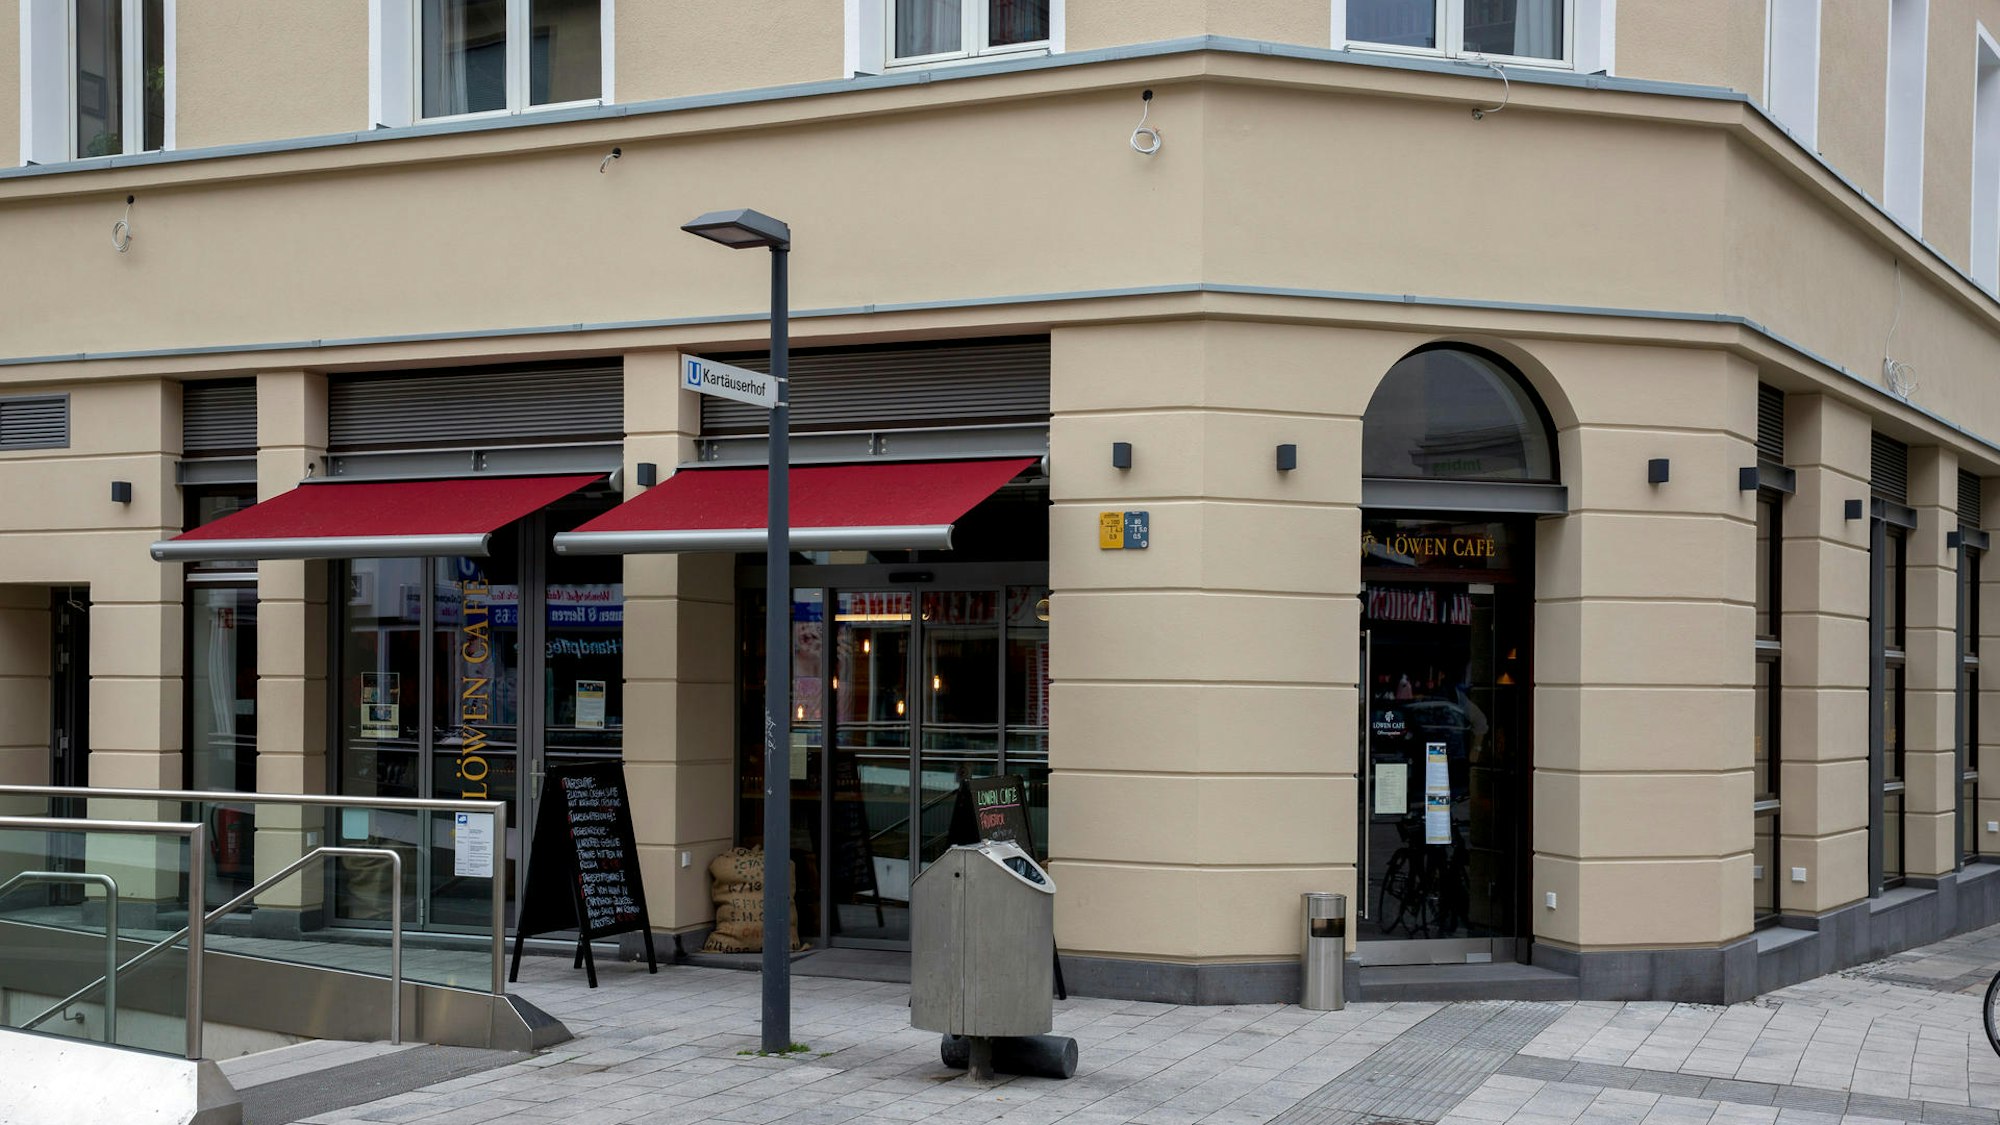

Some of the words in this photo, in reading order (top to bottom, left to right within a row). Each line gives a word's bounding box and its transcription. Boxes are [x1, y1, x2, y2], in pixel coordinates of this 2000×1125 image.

[703, 368, 767, 396] Kartäuserhof
[1384, 534, 1448, 557] LÖWEN
[1452, 534, 1496, 558] CAFÉ
[456, 677, 489, 800] LÖWEN
